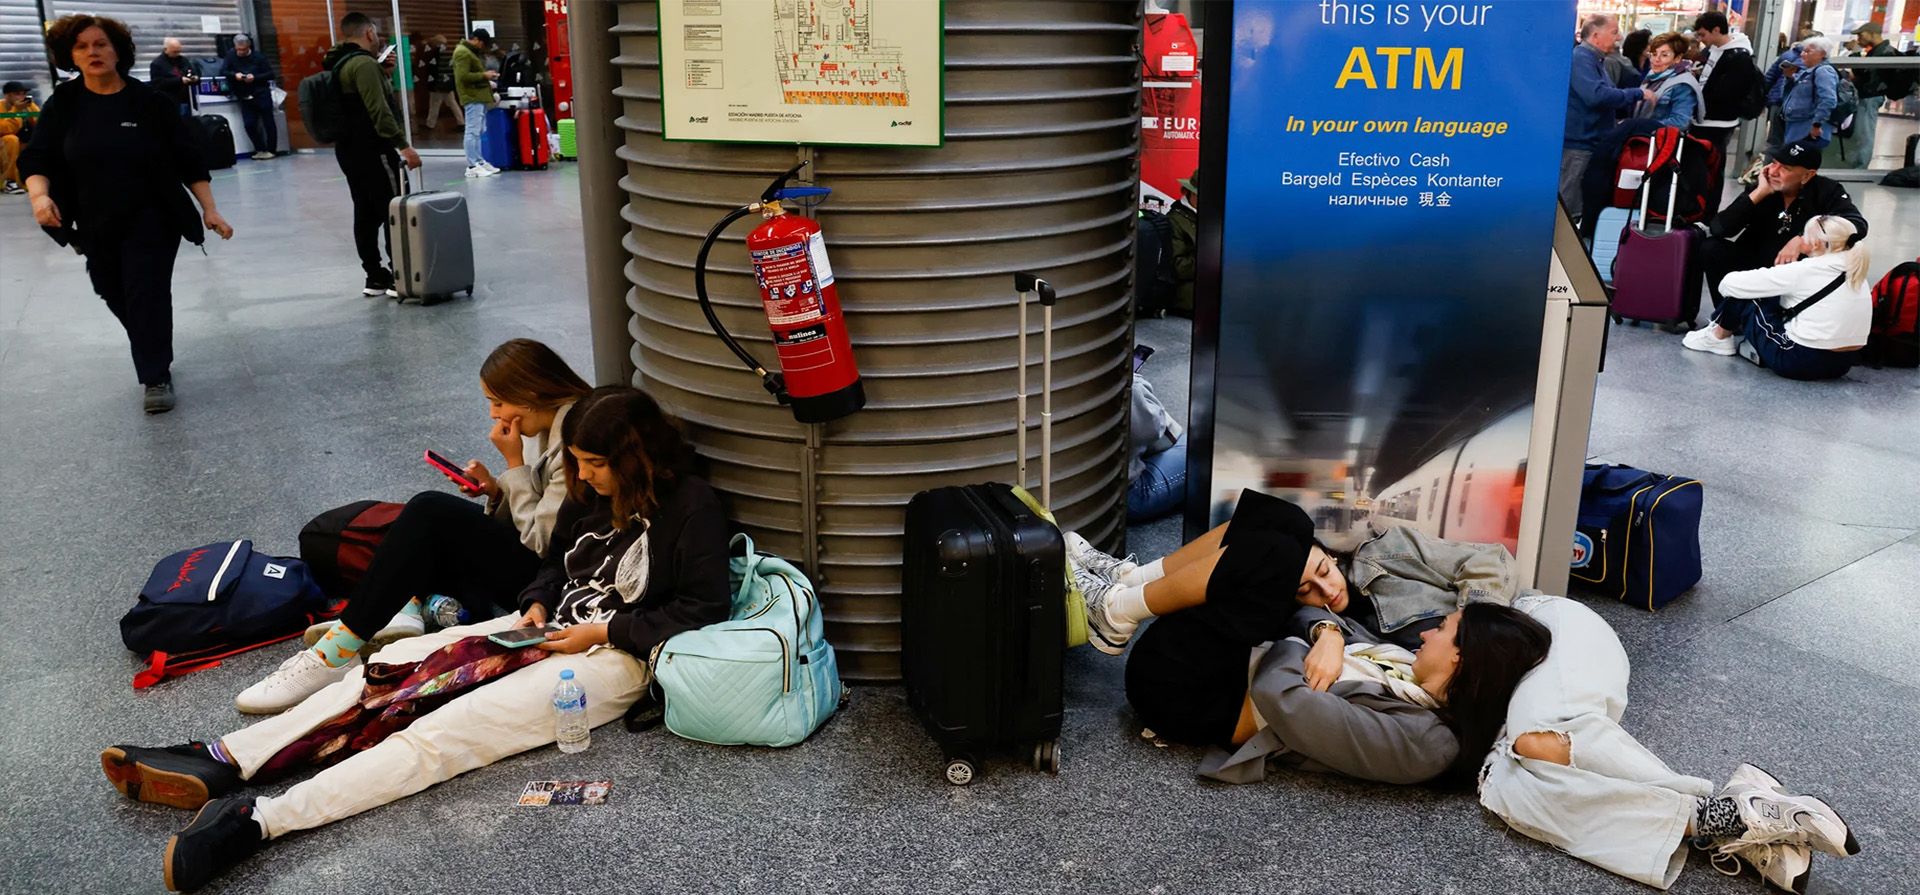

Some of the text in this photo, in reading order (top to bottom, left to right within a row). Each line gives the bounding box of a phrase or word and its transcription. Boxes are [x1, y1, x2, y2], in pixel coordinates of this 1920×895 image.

[1319, 0, 1493, 32] this is your
[1334, 47, 1464, 90] ATM
[1164, 117, 1200, 130] EUR
[1285, 115, 1508, 138] In your own language
[1163, 130, 1195, 140] AUTOMATIC
[1338, 152, 1450, 167] Efectivo Cash
[1281, 172, 1503, 189] Bargeld Espèces Kontanter
[1328, 194, 1408, 207] наличные
[1419, 191, 1452, 207] 現金
[1761, 802, 1781, 820] N
